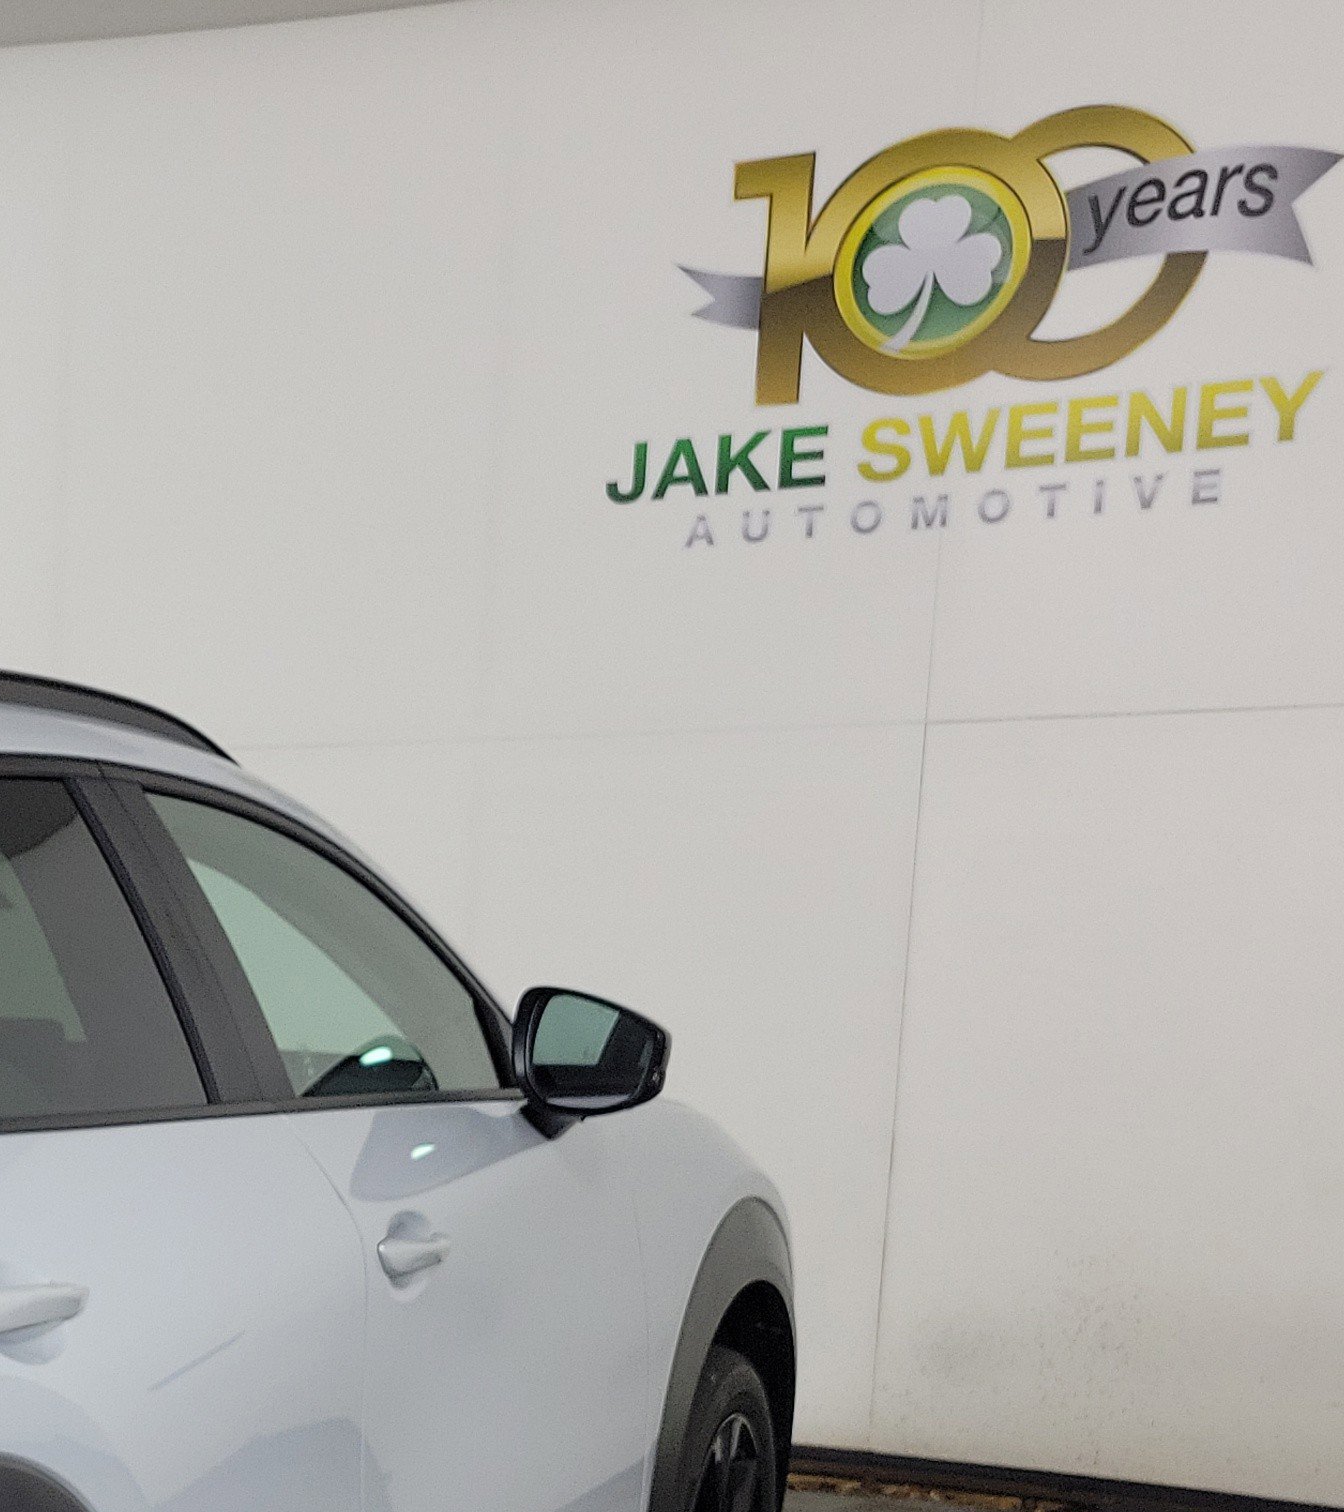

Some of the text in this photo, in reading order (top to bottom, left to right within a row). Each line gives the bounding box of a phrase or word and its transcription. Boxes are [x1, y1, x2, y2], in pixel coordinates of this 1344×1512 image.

[734, 104, 1279, 405] 100 years
[605, 369, 1326, 504] JAKE SWEENEY
[684, 467, 1223, 549] AUTOMOTIVE
